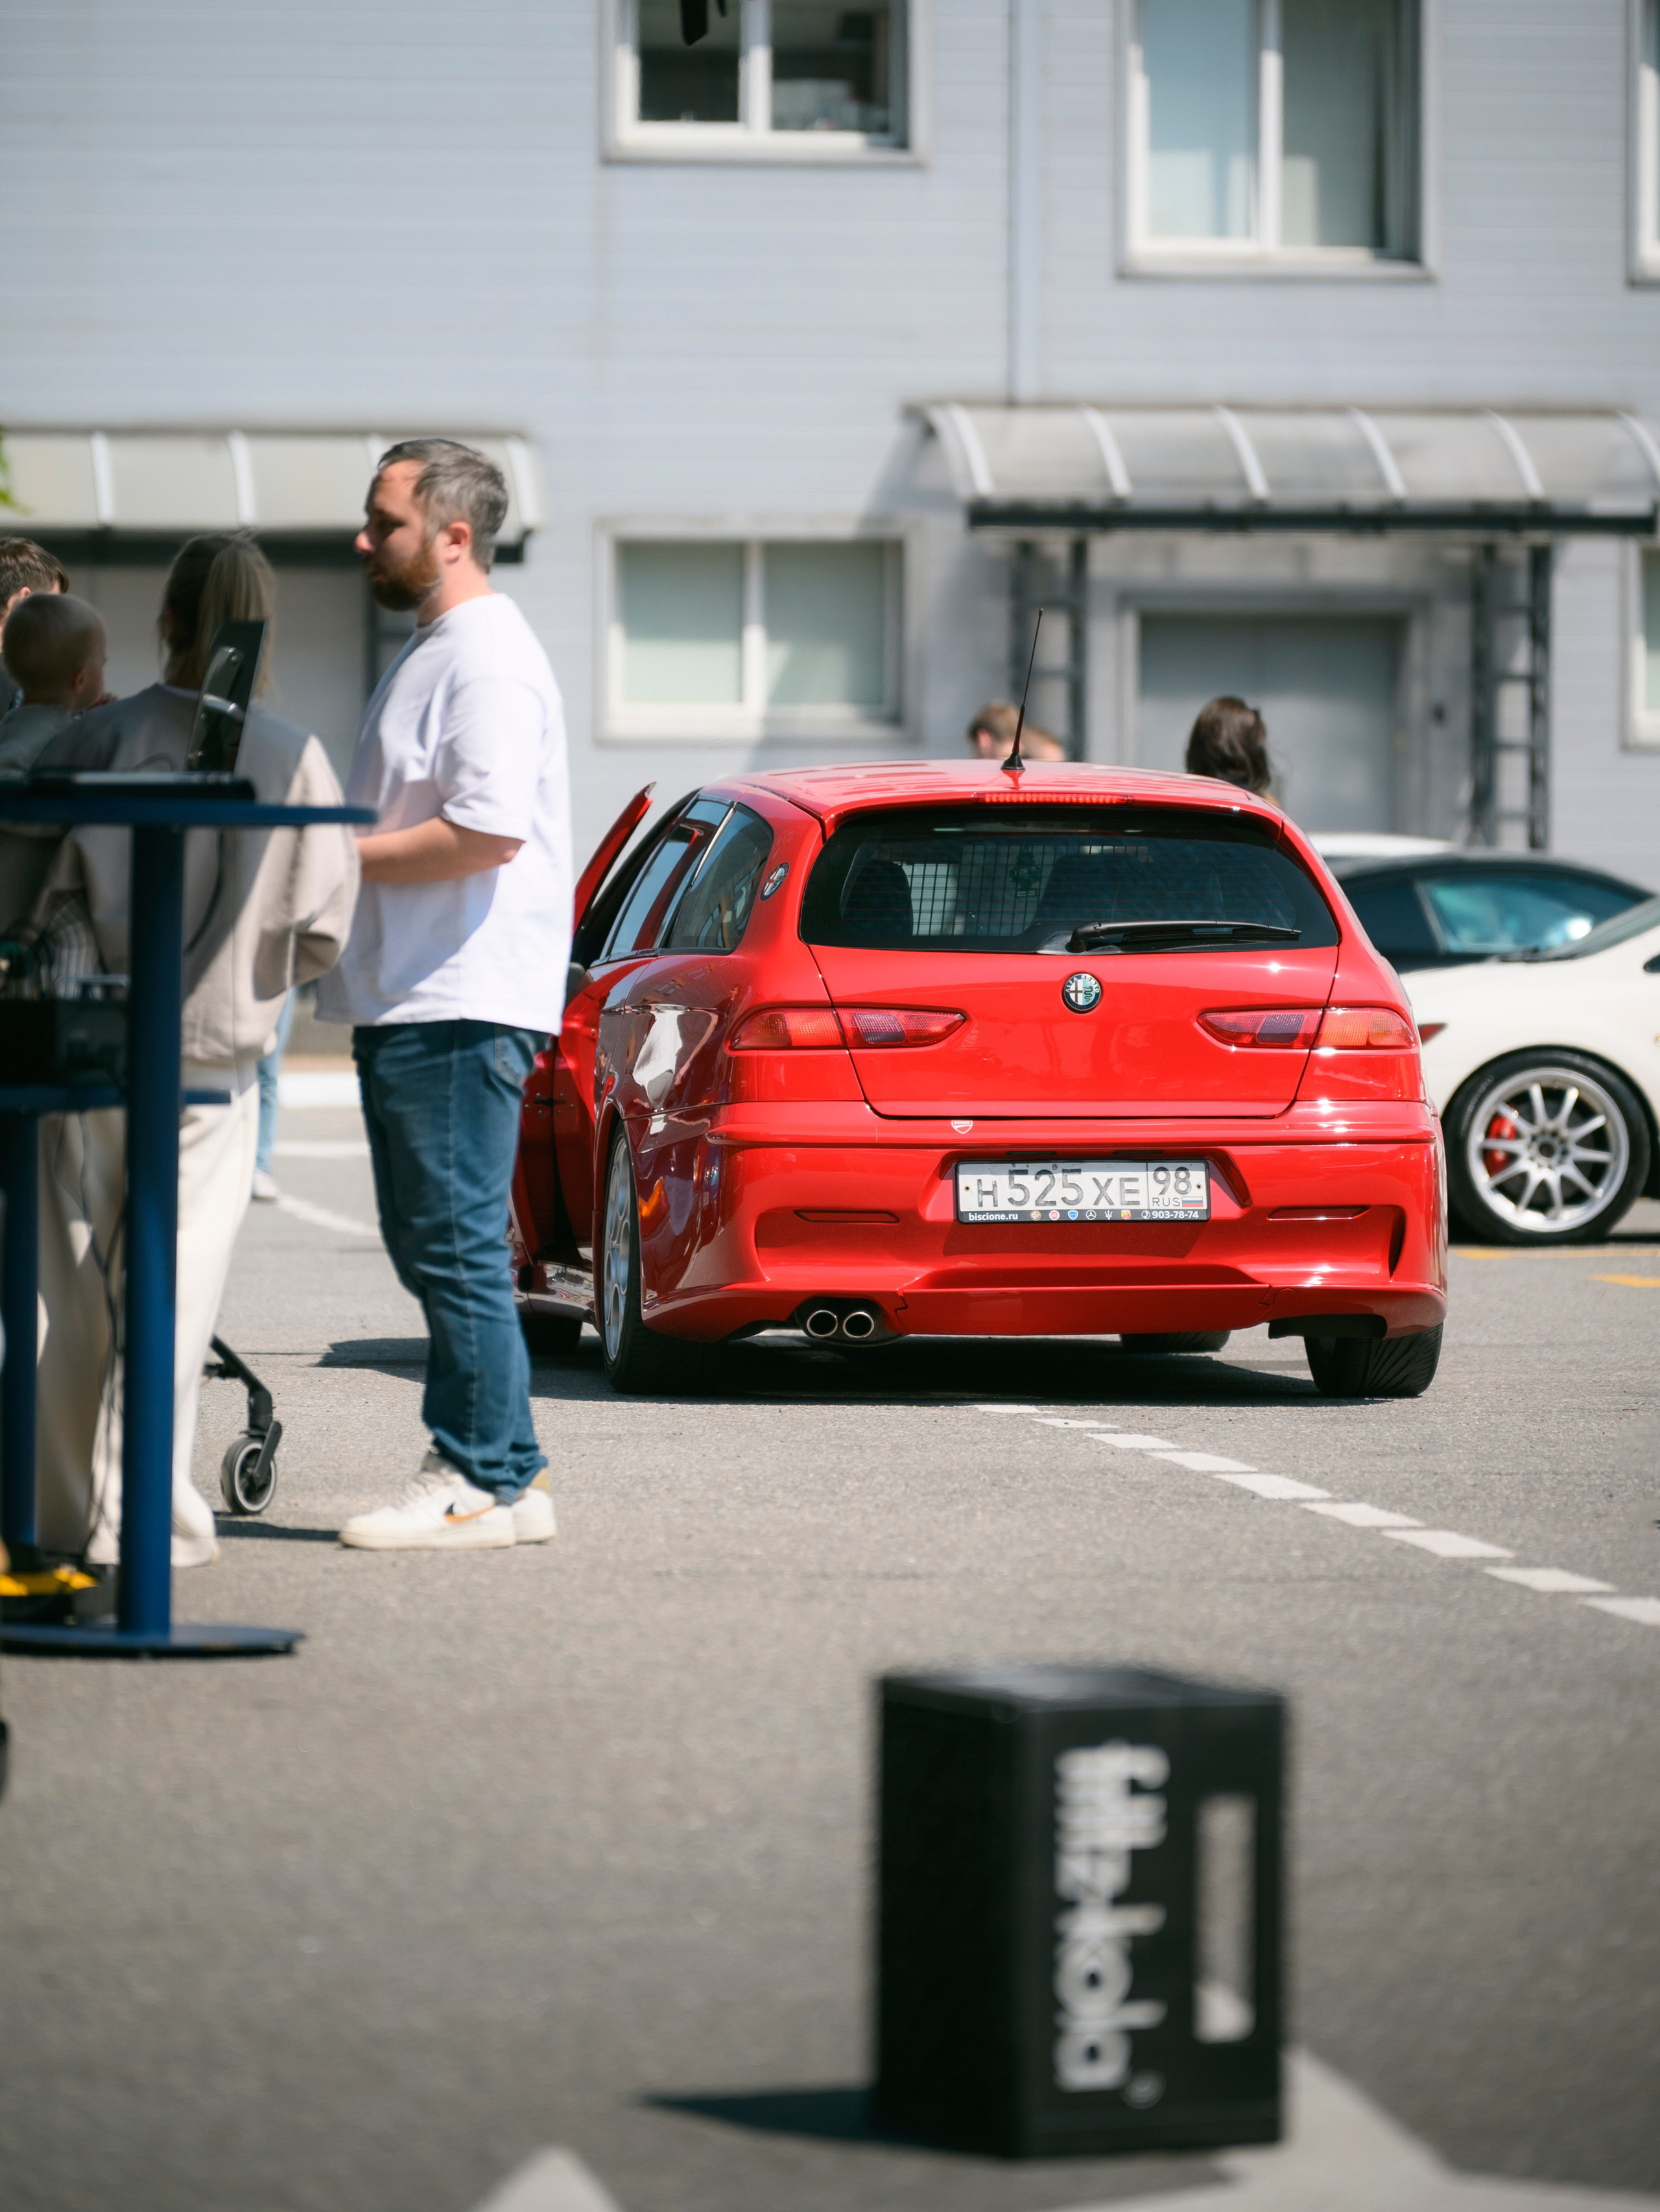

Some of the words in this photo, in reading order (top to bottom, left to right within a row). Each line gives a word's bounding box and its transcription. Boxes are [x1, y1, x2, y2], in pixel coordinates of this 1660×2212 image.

[1065, 976, 1078, 993] ALFA
[1080, 974, 1100, 994] ROMEO
[1153, 1166, 1192, 1195] 98
[1152, 1197, 1181, 1207] RUS
[968, 1212, 1019, 1221] biscione.ru
[1152, 1210, 1200, 1219] 903-78-74
